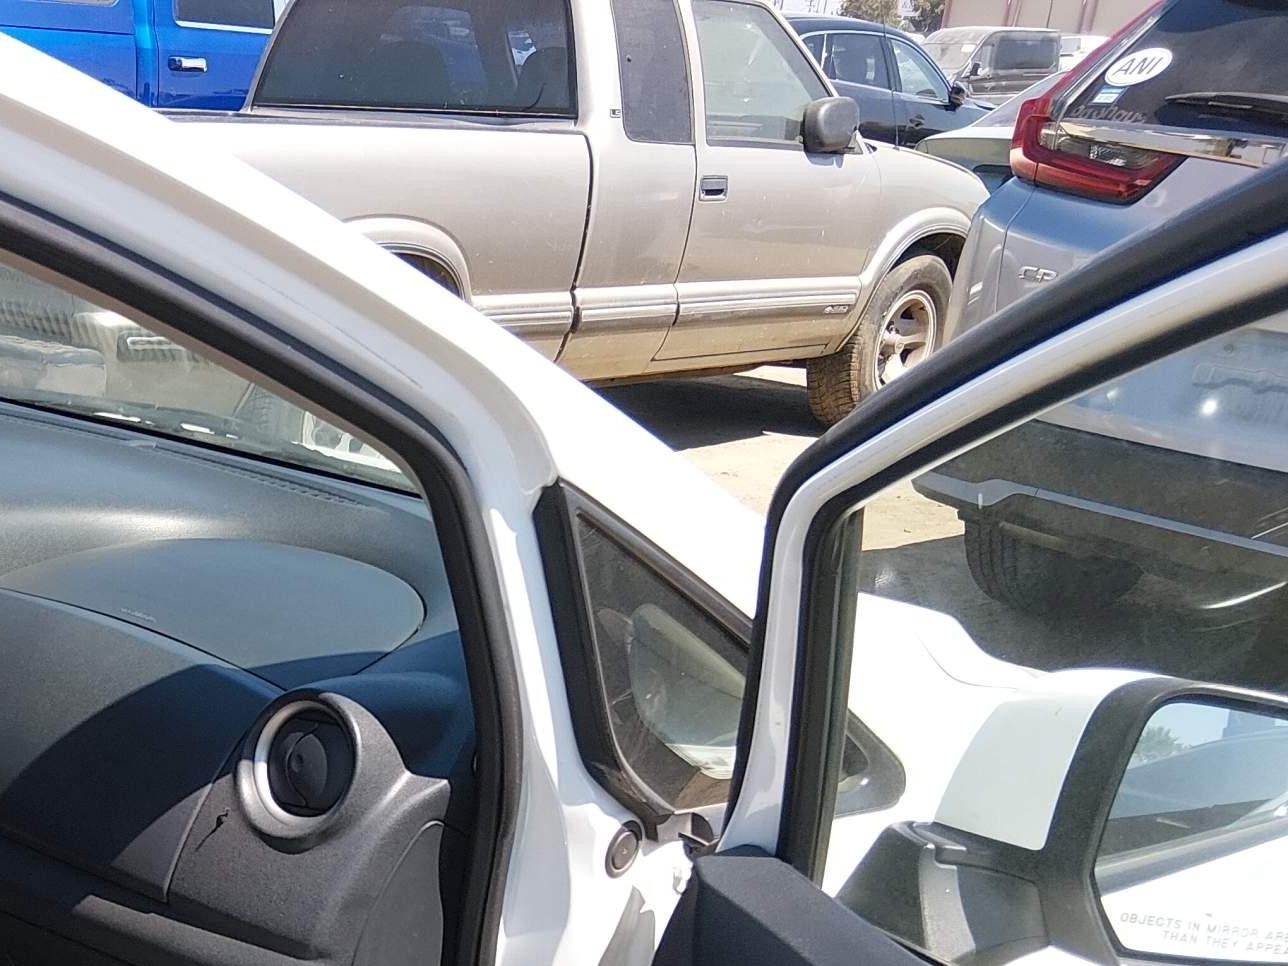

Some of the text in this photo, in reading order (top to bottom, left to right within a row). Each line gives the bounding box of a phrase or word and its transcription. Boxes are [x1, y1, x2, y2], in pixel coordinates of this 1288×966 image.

[1111, 57, 1164, 76] ANI
[1119, 912, 1183, 930] OBJECTS
[1188, 921, 1201, 931] IN
[1207, 924, 1259, 938] MIRROR
[1162, 930, 1288, 956] THAN THEY APPEA
